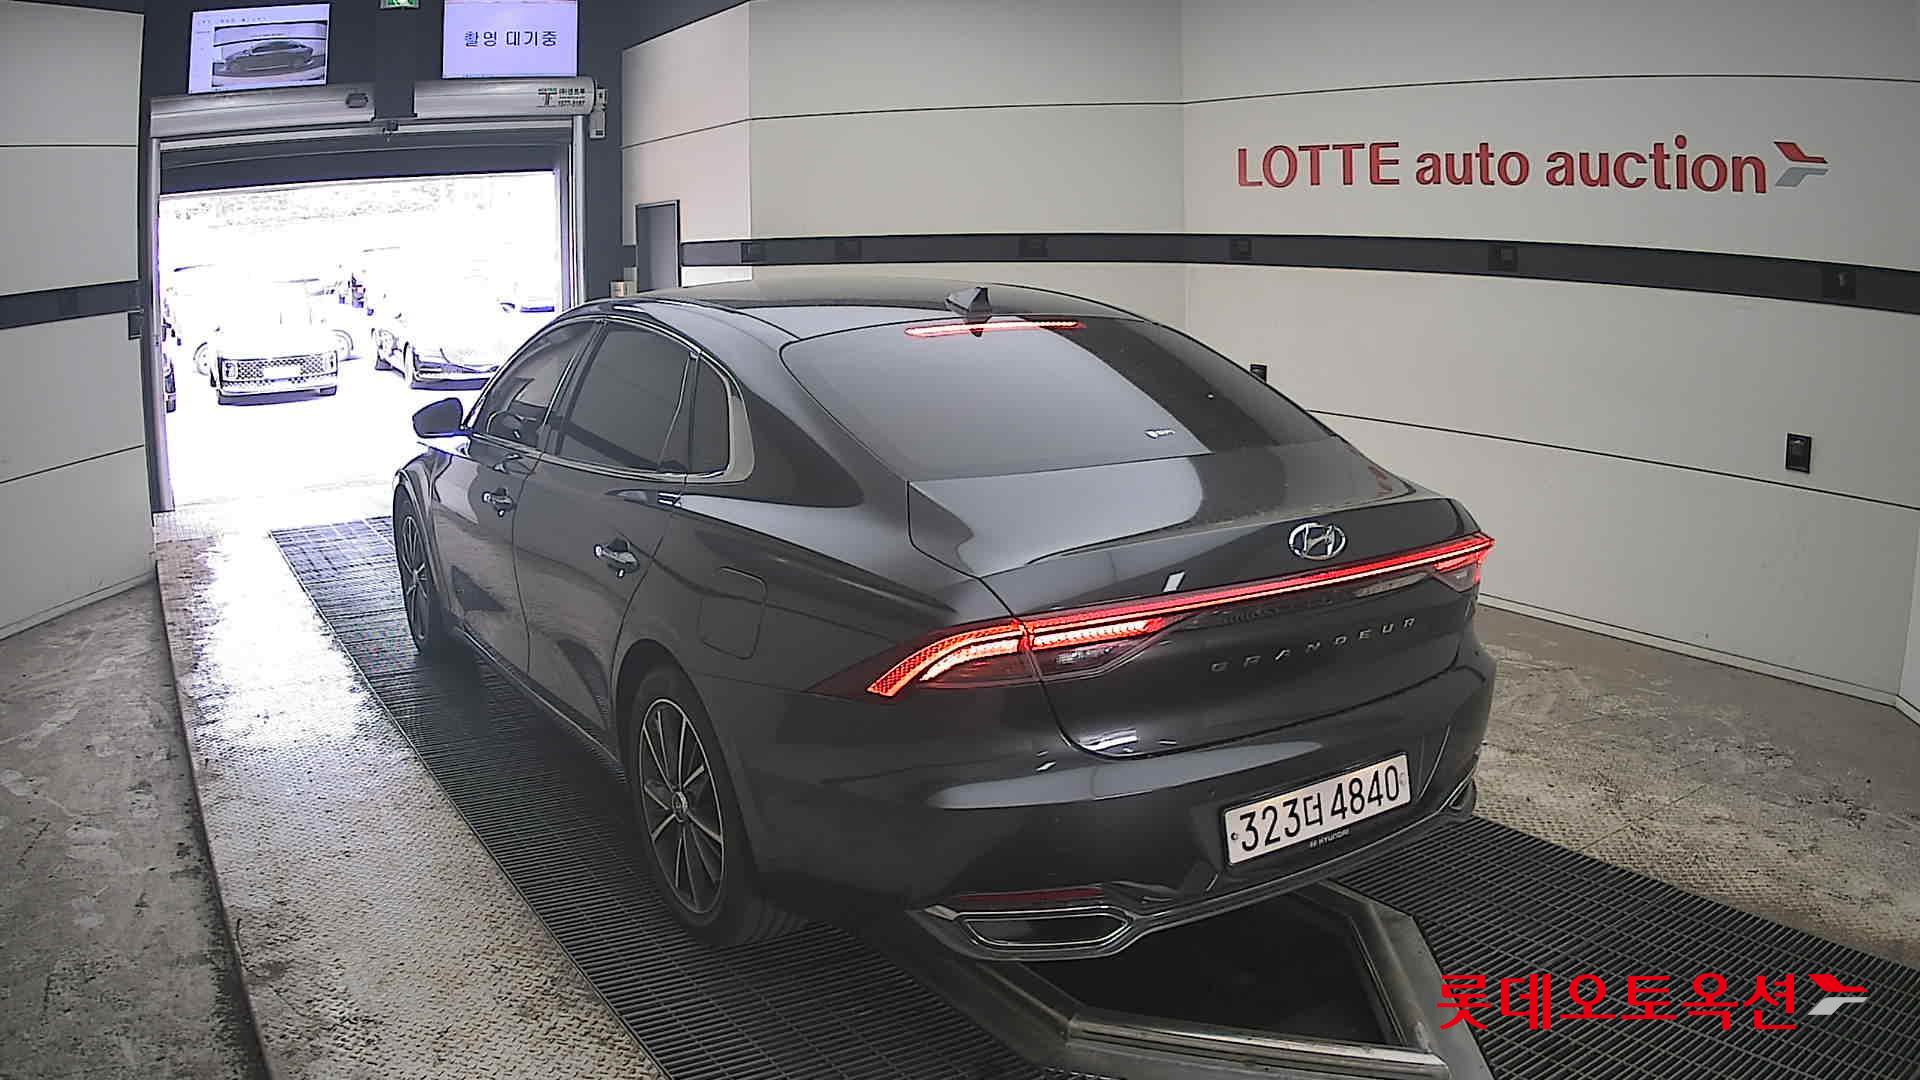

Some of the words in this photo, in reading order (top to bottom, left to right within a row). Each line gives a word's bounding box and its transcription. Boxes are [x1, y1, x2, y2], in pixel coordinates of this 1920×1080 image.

[506, 31, 557, 47] 대기중
[1238, 142, 1400, 187] LOTTE
[1415, 142, 1530, 187] auto
[1546, 135, 1768, 194] auction
[1211, 616, 1416, 672] GRANDEUR
[1239, 792, 1324, 852] 323더
[1330, 765, 1400, 820] 4840
